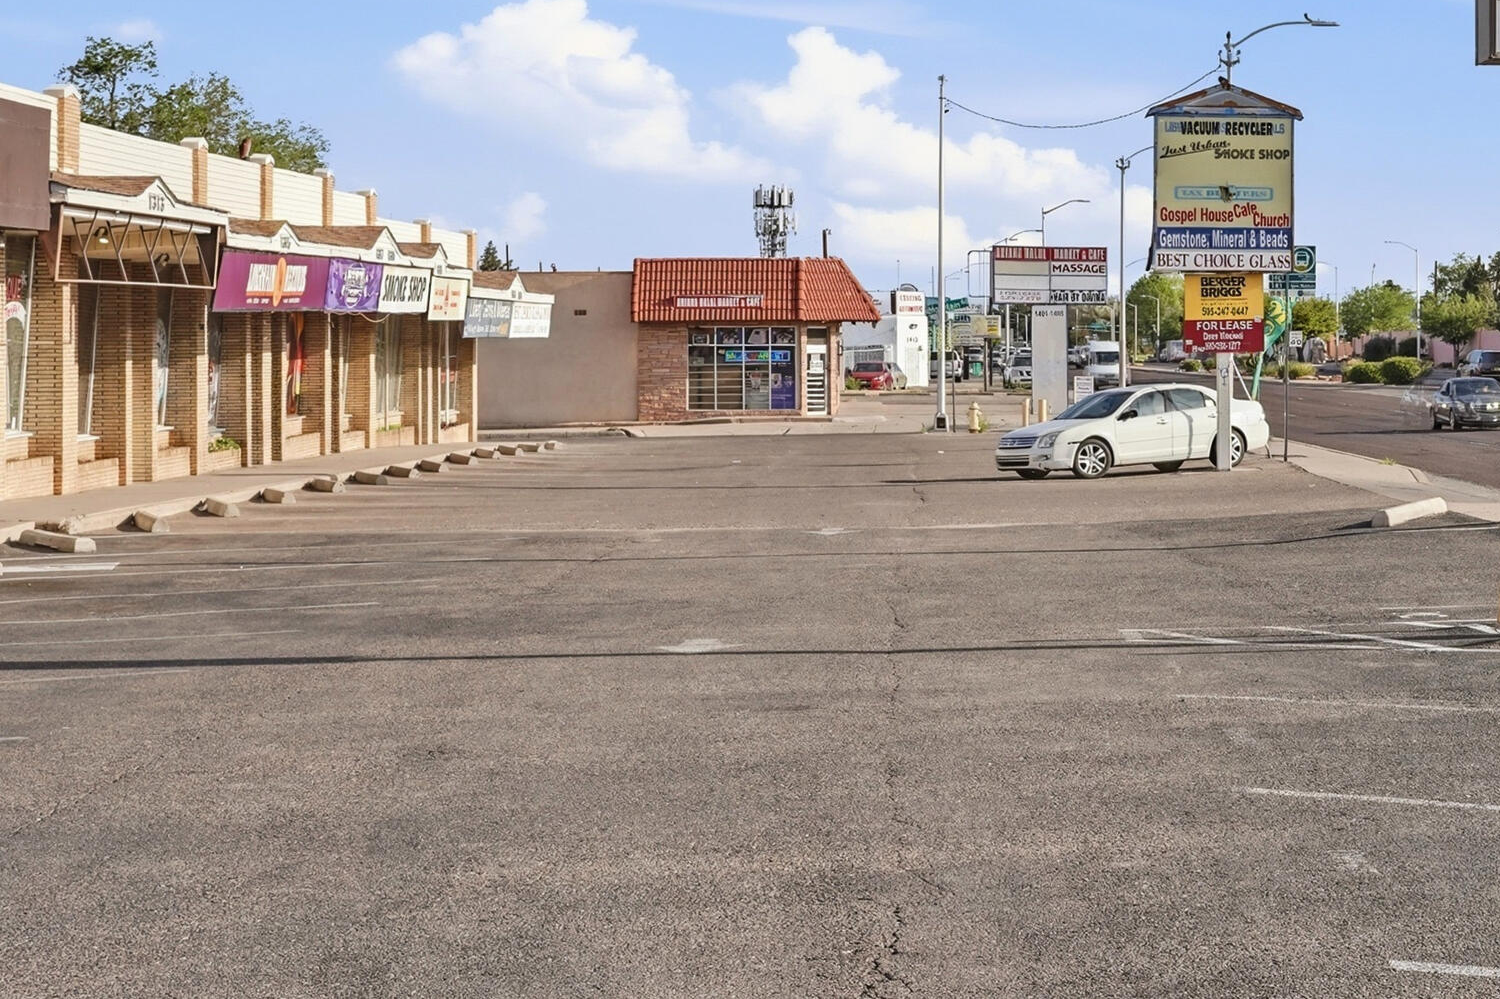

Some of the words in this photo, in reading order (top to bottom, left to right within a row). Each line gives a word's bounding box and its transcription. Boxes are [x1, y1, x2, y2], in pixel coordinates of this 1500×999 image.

[1180, 121, 1220, 135] VACUUM
[1225, 122, 1273, 136] RECYCLER
[1162, 145, 1187, 156] Just
[1259, 149, 1290, 160] SHOP
[1160, 207, 1197, 224] Gospel
[1200, 208, 1233, 222] House
[1252, 212, 1289, 227] Church
[1160, 229, 1210, 248] Gemstone,
[1212, 230, 1246, 247] Mineral
[1249, 230, 1256, 247] &
[1260, 230, 1288, 247] Beads
[1157, 253, 1189, 267] BEST
[1194, 254, 1244, 267] CHOICE
[1249, 255, 1291, 268] GLASS
[1052, 264, 1105, 273] MASSAGE
[383, 274, 408, 302] SMOKE
[408, 276, 427, 302] SHOP
[1201, 276, 1246, 287] BERGER
[1201, 287, 1242, 298] BRIGGS
[1196, 321, 1218, 330] FOR
[1220, 321, 1253, 330] LEASE
